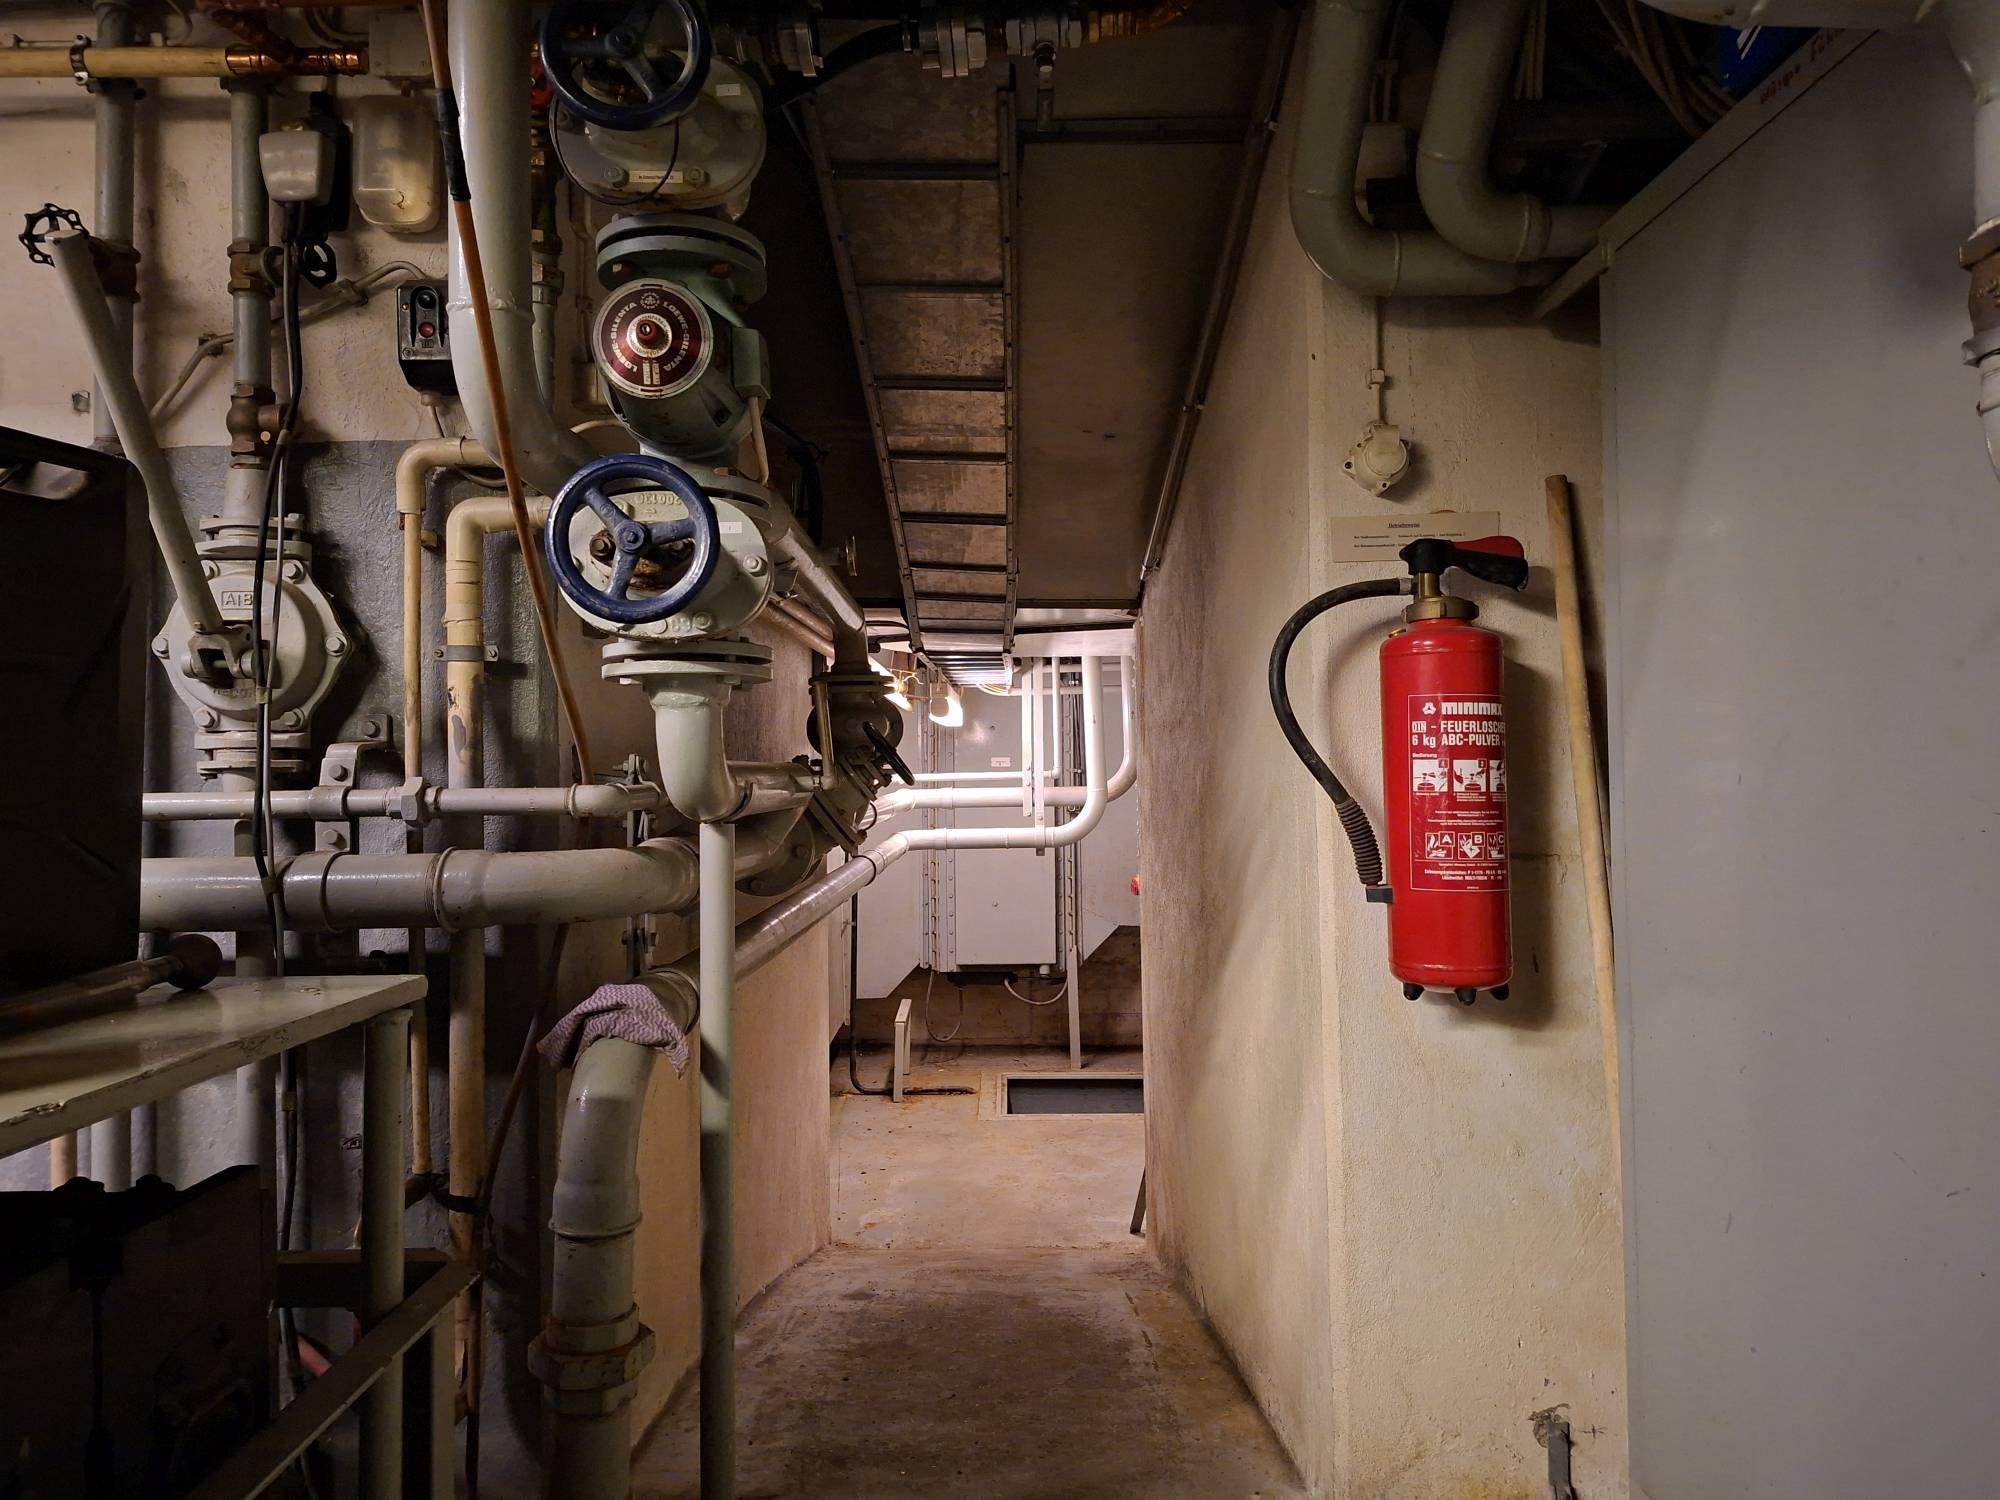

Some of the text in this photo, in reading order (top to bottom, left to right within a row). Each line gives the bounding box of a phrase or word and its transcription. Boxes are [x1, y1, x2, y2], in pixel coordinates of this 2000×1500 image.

[1412, 735, 1418, 745] 6
[1423, 734, 1436, 748] kg
[1441, 734, 1500, 746] ABC-PULVER
[1441, 834, 1453, 843] A
[1474, 834, 1482, 843] B
[1498, 834, 1504, 843] C
